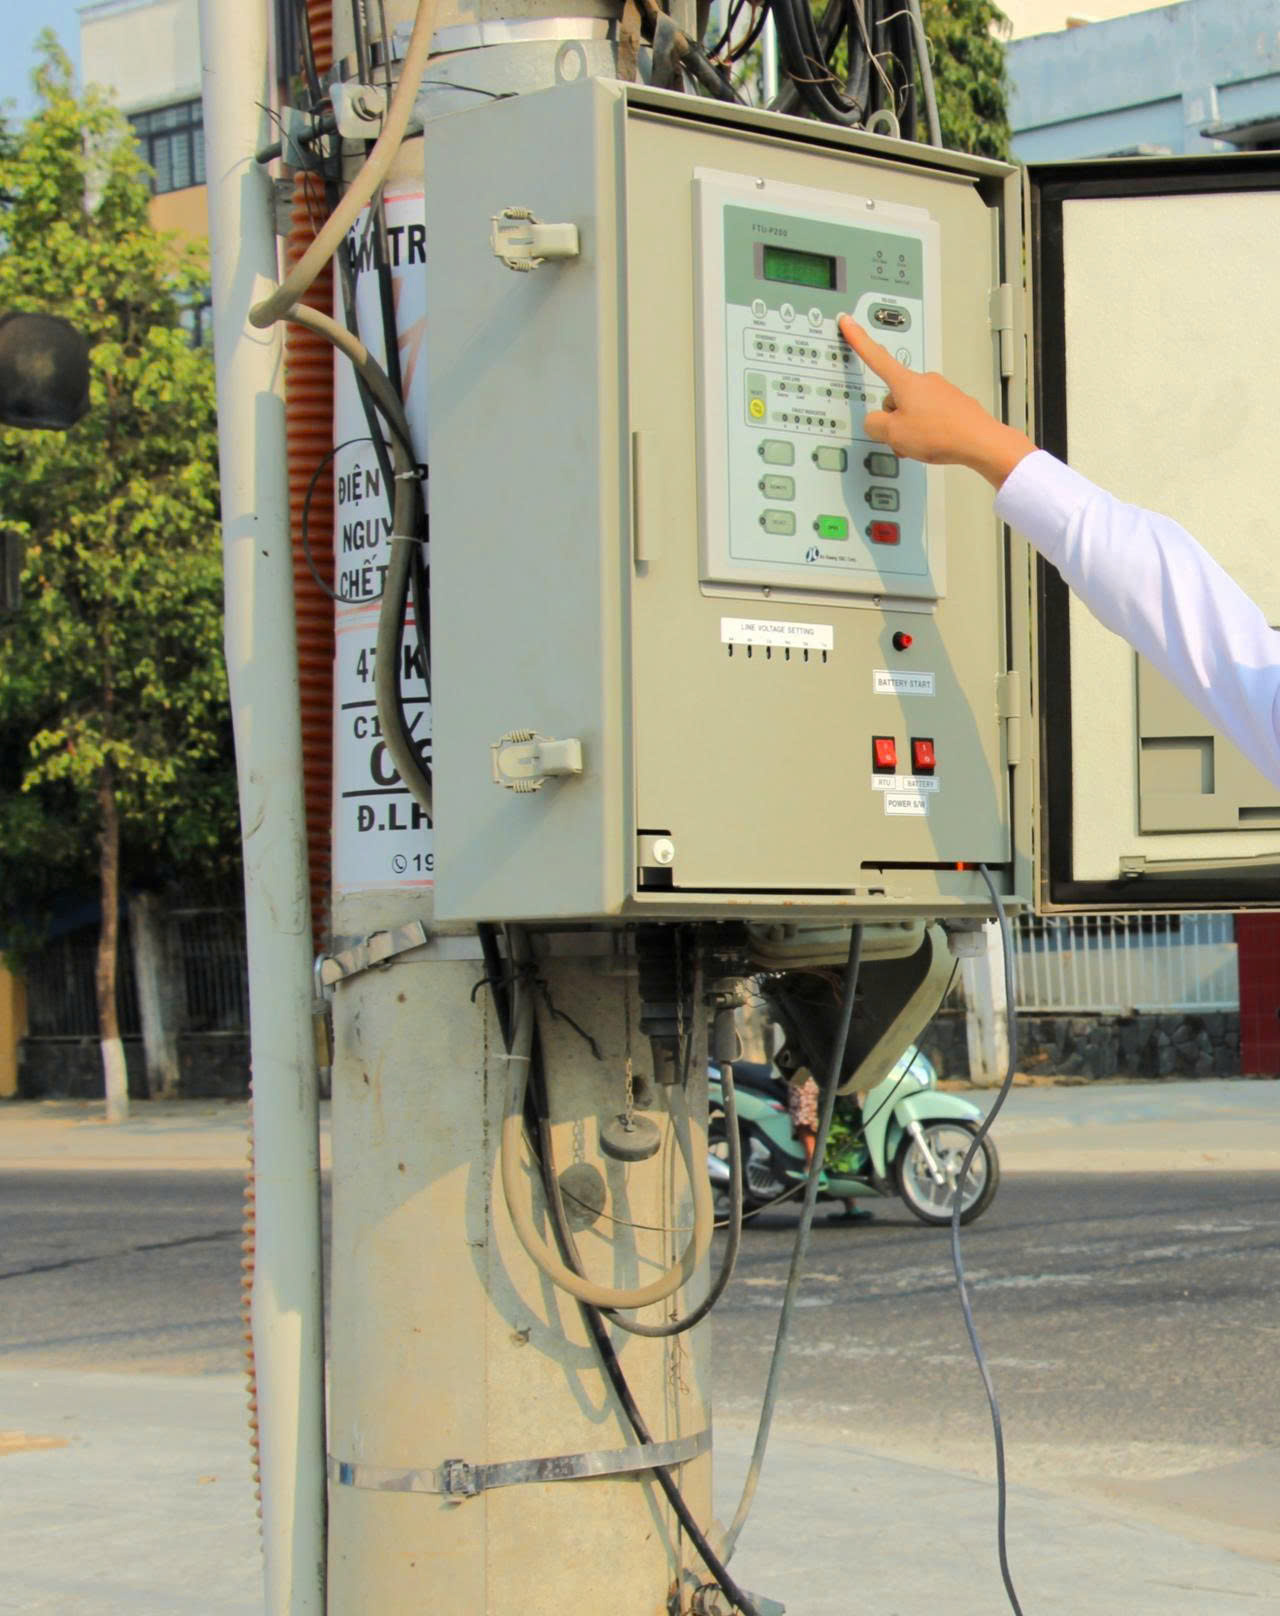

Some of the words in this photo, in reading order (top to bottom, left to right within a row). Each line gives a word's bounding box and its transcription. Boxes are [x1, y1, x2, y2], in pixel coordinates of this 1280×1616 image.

[338, 463, 380, 506] ĐIỆN
[740, 623, 756, 632] LINE
[758, 624, 785, 634] VOLTAGE
[787, 626, 815, 636] SETTING
[877, 678, 908, 688] BATTERY
[909, 679, 931, 689] START
[888, 799, 911, 808] POWER
